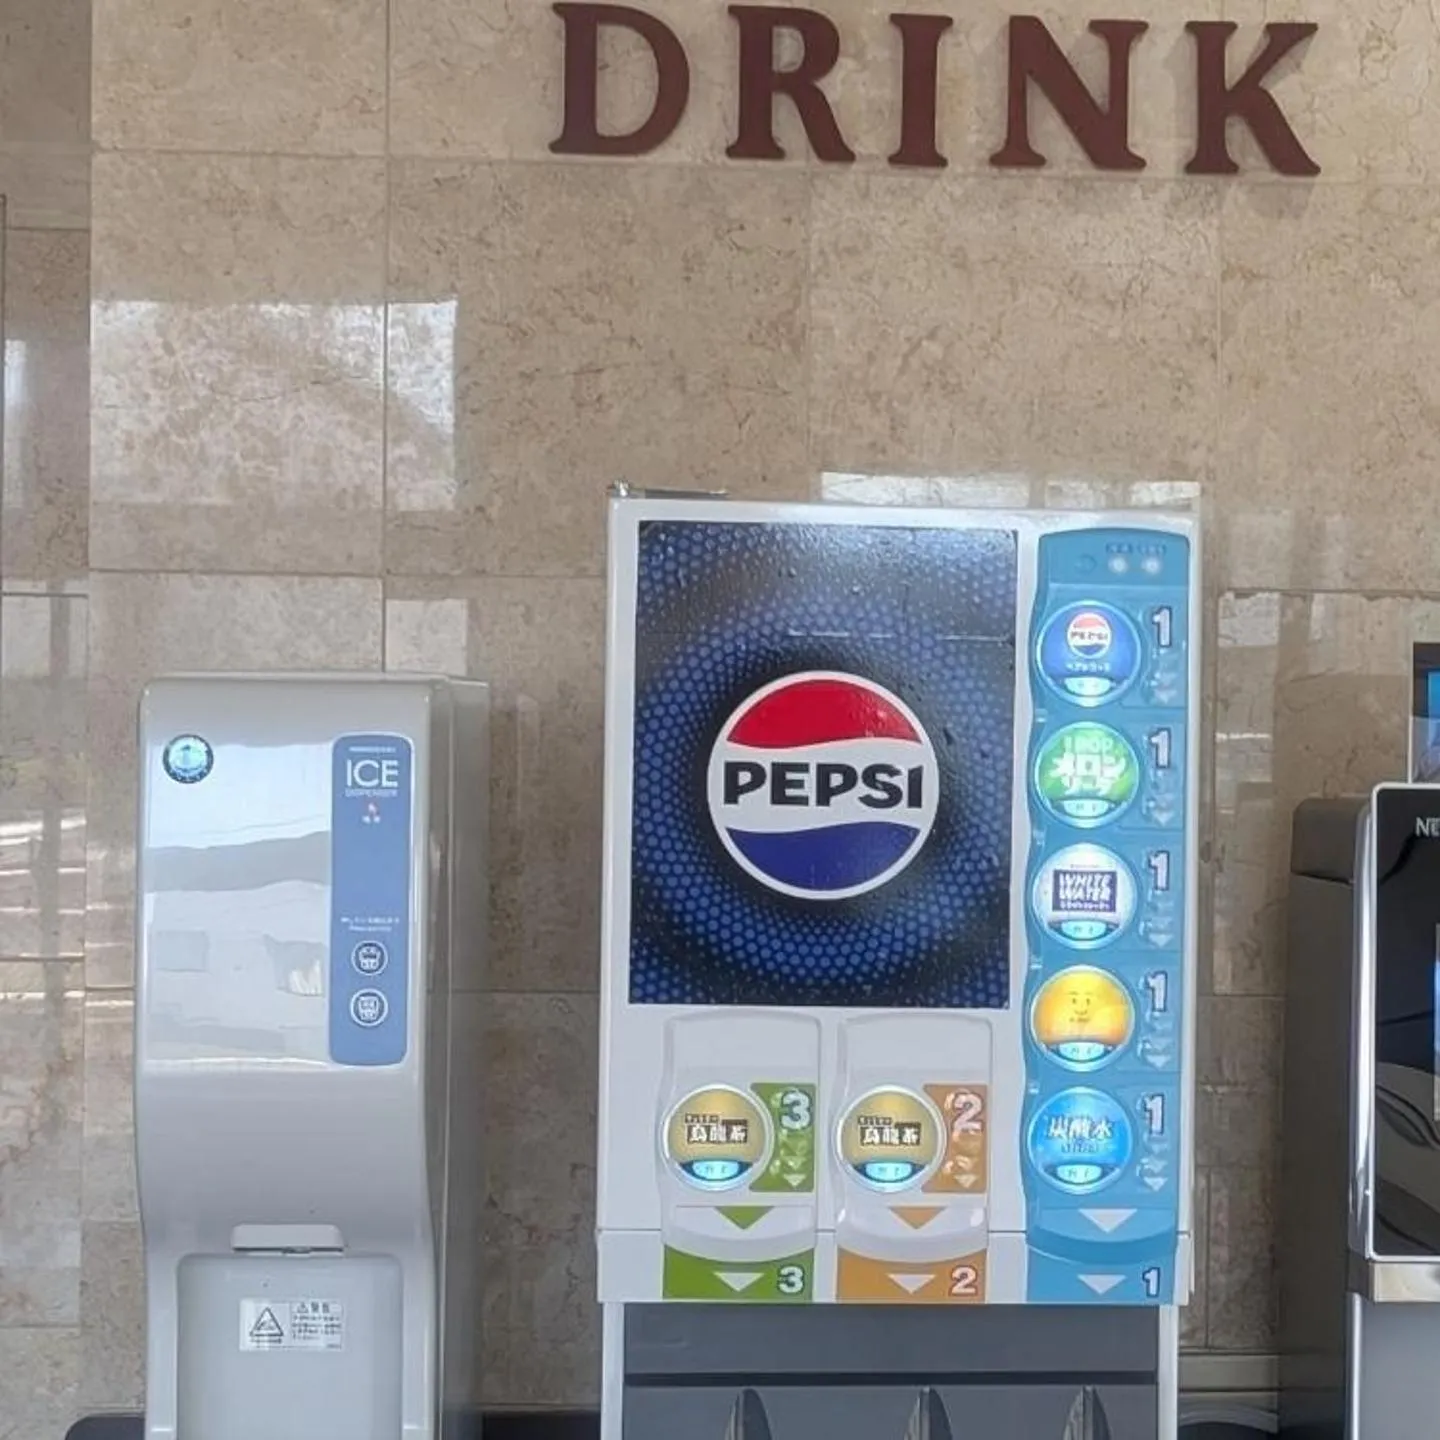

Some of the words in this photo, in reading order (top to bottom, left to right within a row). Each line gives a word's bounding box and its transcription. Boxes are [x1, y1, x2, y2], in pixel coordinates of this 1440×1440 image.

[548, 2, 1321, 177] DRINK
[1151, 604, 1173, 648] 1
[1150, 728, 1172, 770] 1
[346, 759, 399, 787] ICE
[723, 761, 924, 810] PEPSI
[1149, 850, 1171, 892] 1
[1147, 971, 1168, 1012] 1
[780, 1091, 813, 1131] 3
[951, 1092, 984, 1133] 2
[1144, 1093, 1166, 1135] 1
[779, 1267, 805, 1294] 3
[951, 1267, 978, 1295] 2
[1142, 1268, 1161, 1298] 1
